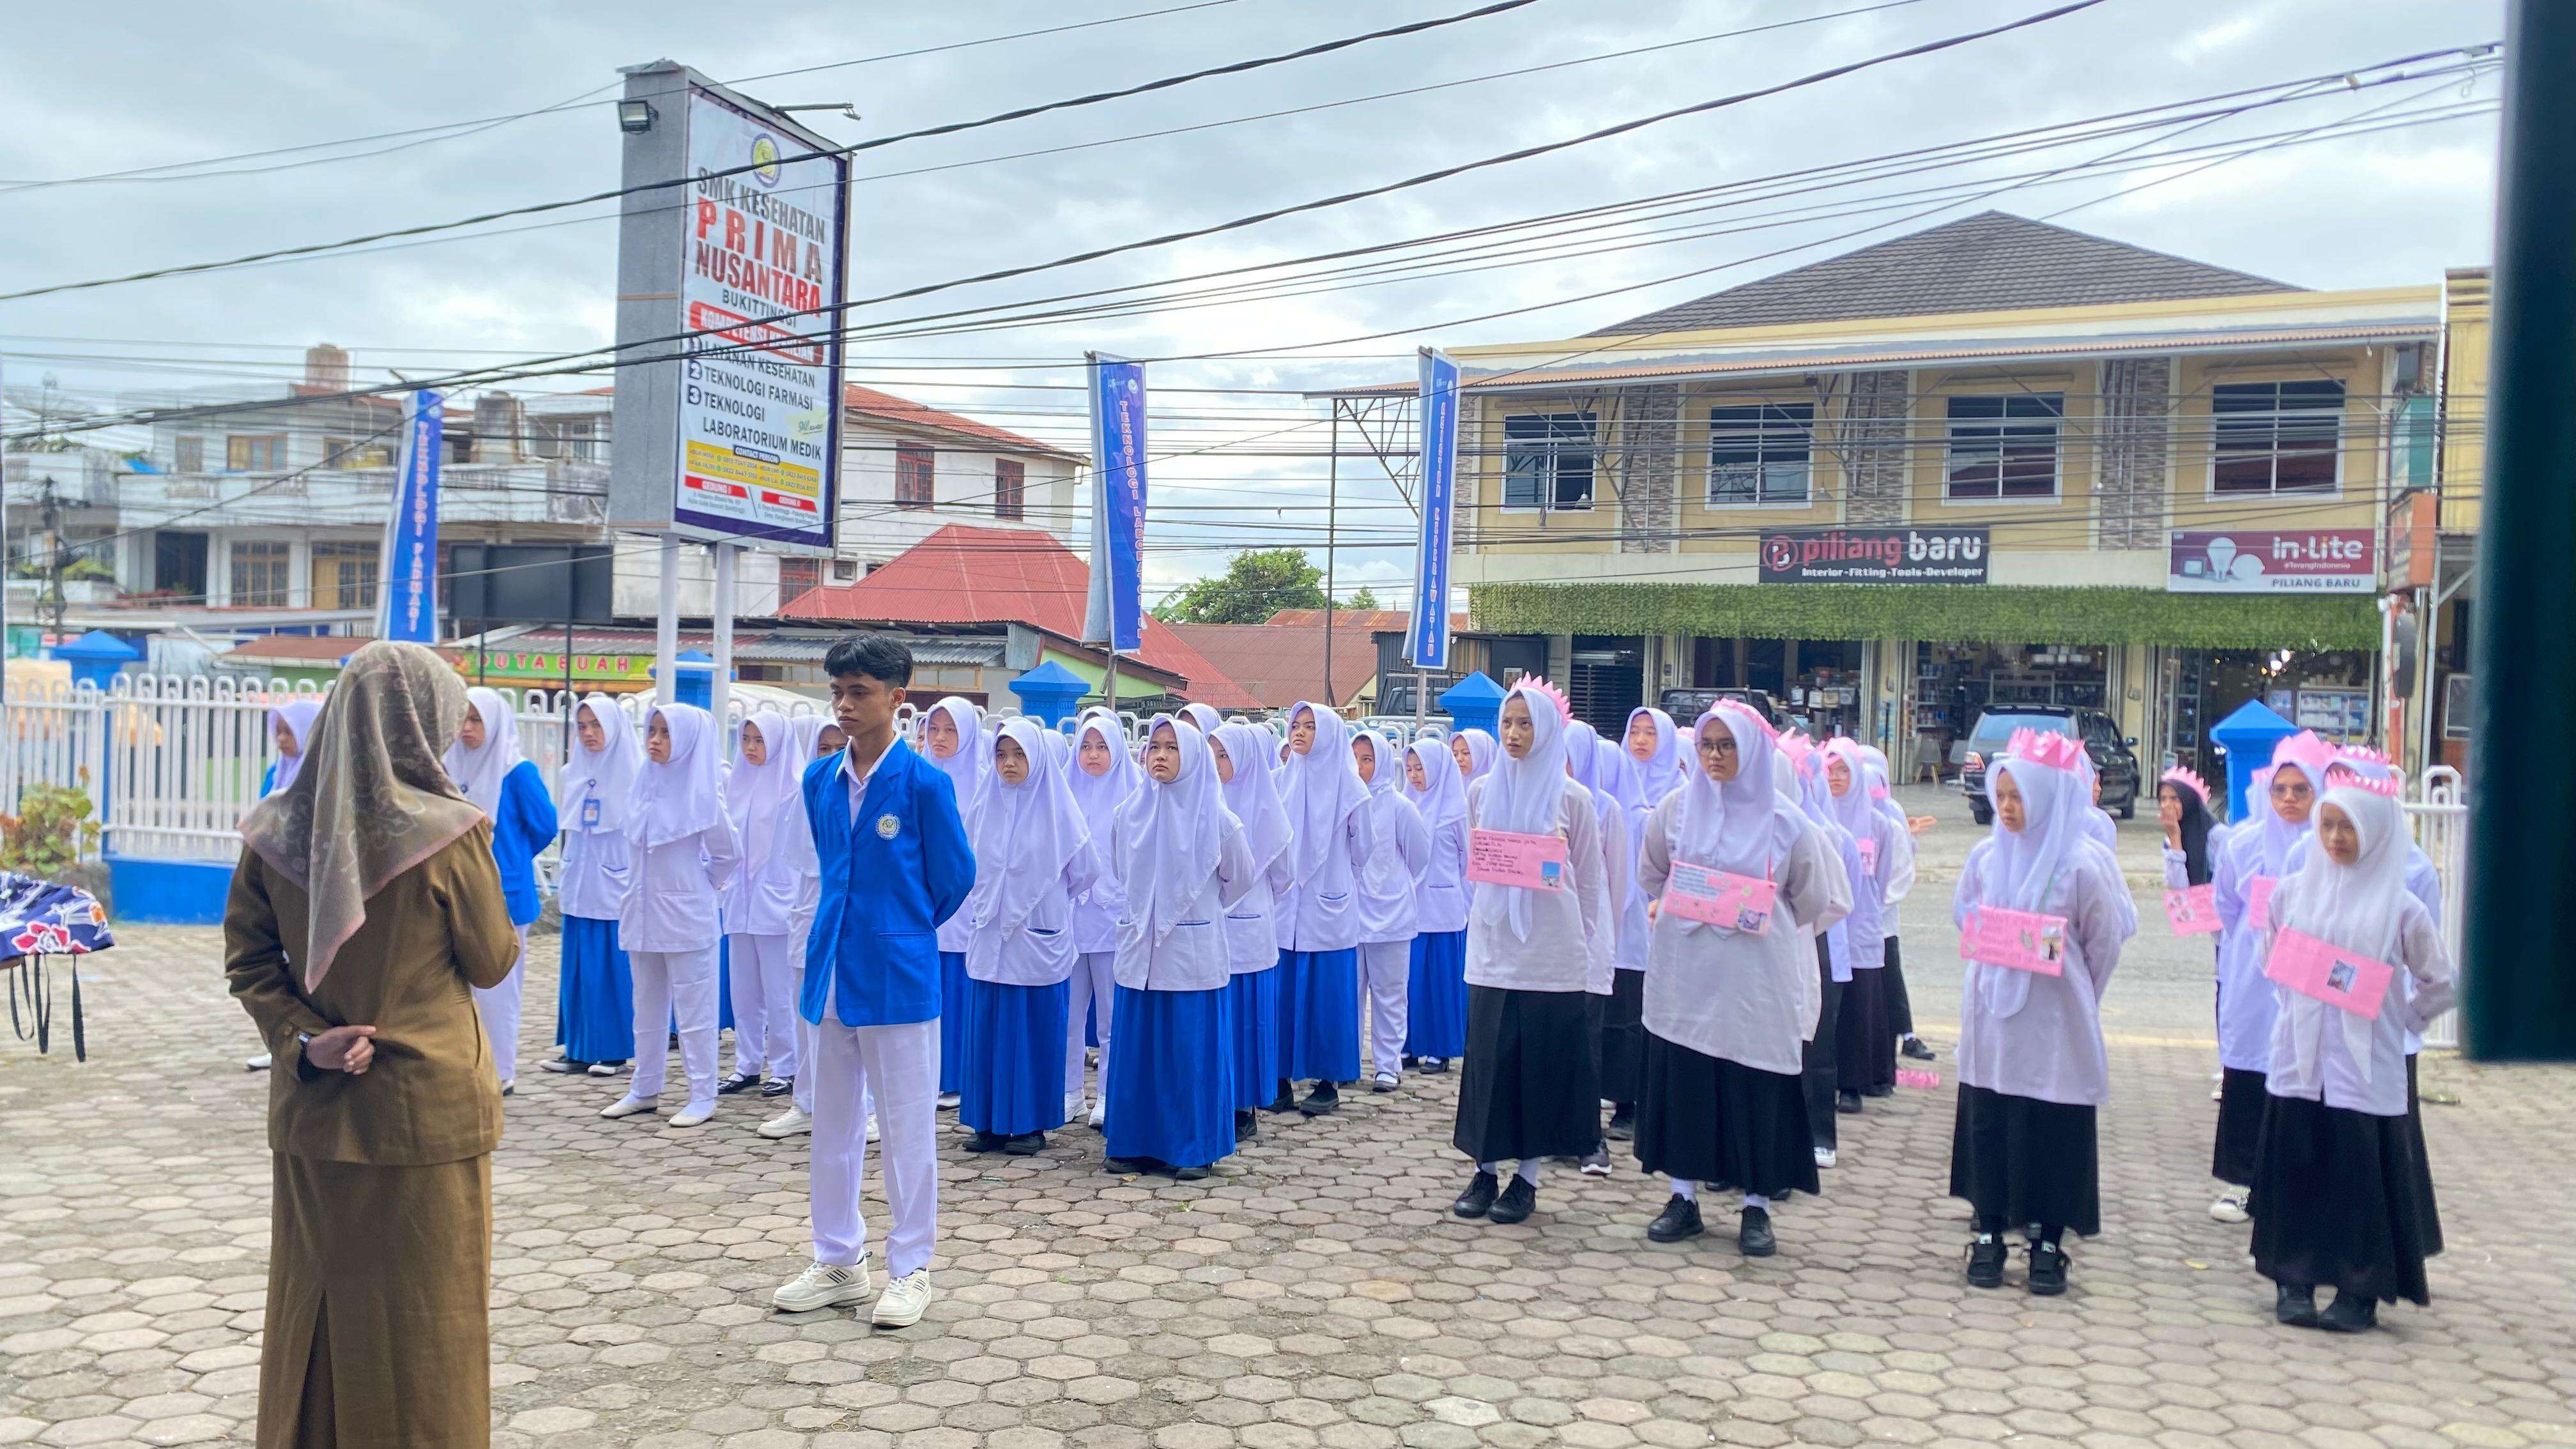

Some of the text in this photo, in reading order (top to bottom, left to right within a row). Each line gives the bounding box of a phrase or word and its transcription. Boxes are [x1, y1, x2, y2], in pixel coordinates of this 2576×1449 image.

[697, 166, 825, 244] SMK KESEHATAN
[697, 196, 822, 284] PRIMA
[696, 240, 821, 318] NUSANTARA
[723, 289, 795, 327] BUKITTINGGI
[705, 365, 765, 397] TEKNOLOGI
[769, 385, 813, 411] FARMASI
[758, 357, 815, 388] KESEHATAN
[704, 391, 765, 422] TEKNOLOGI
[703, 417, 787, 451] LABORATORIUM
[791, 438, 821, 461] MEDIK
[1119, 400, 1138, 501] TEKNOLOGI
[1802, 530, 1982, 567] piliang baru
[2273, 535, 2363, 560] in-lite
[1427, 507, 1440, 657] KEPERAWATAN
[2272, 578, 2361, 587] PILIANG BARU
[556, 654, 629, 672] BUAH
